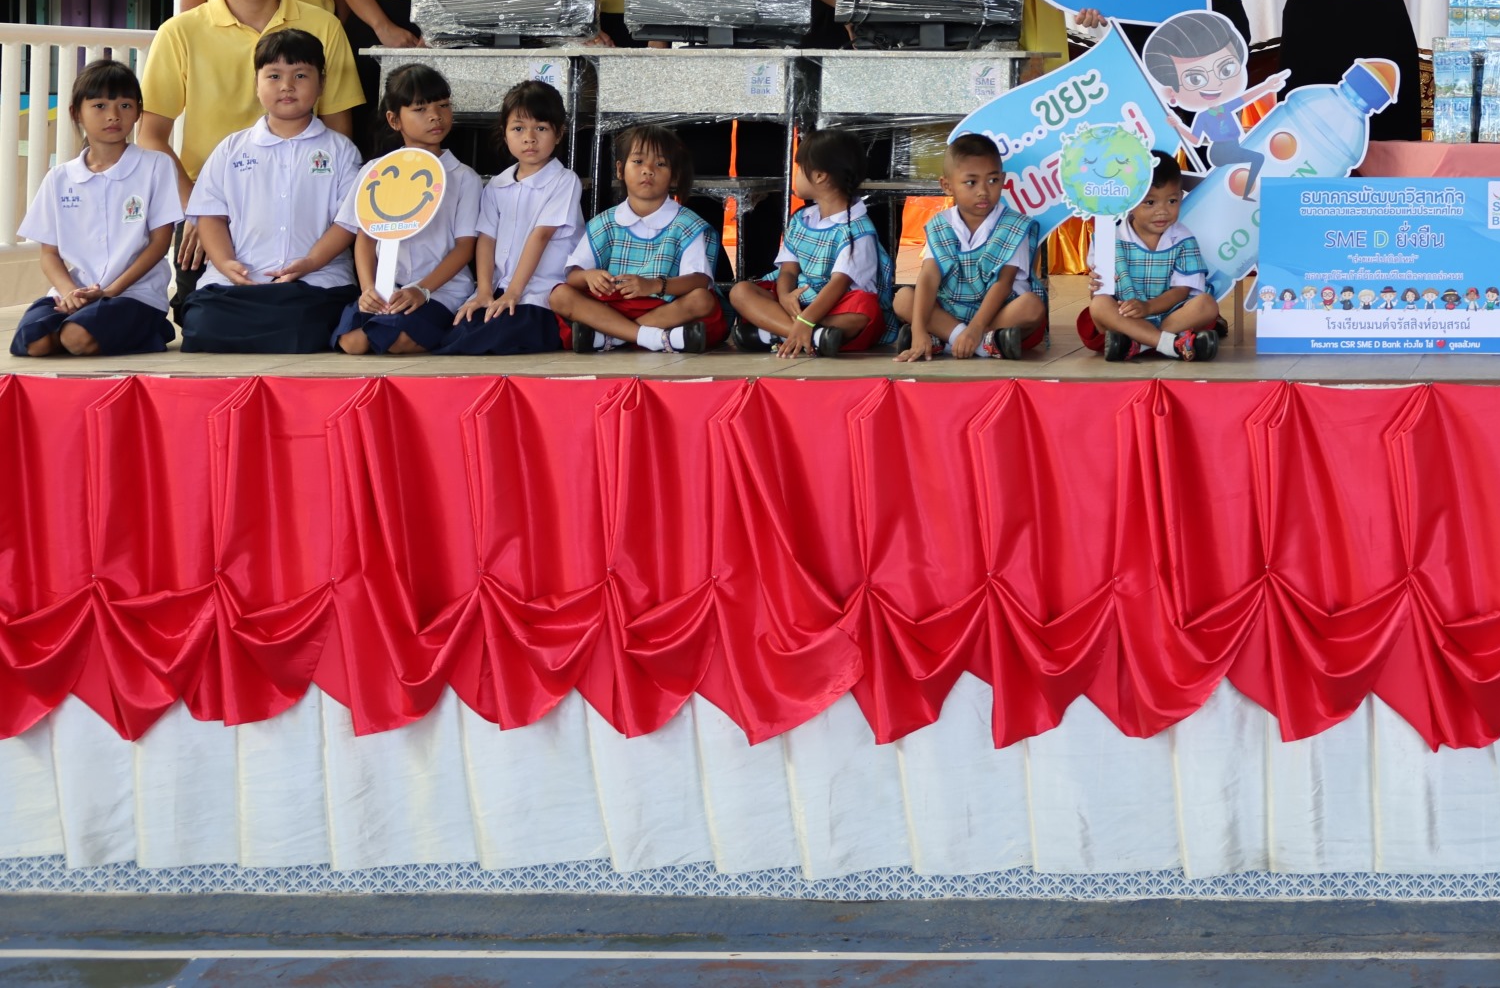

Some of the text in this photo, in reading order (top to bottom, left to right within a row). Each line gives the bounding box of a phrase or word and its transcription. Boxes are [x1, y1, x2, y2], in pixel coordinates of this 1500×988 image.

[534, 75, 555, 83] SME
[751, 76, 771, 85] SME
[975, 77, 996, 86] SME
[1084, 180, 1130, 197] รักษ์โลก
[1300, 186, 1466, 205] ธนาคารพัฒนาวิสาหกิจ
[370, 223, 390, 233] SME
[397, 221, 419, 230] Bank
[1323, 221, 1446, 249] SME D ยั่งยืน
[1217, 228, 1250, 262] GO
[1326, 316, 1472, 333] โรงเรียนมนต์จรัสสิงห์อนุสรณ์
[1310, 339, 1339, 349] โครงการ
[1340, 339, 1356, 349] CSR
[1357, 339, 1373, 349] SME
[1374, 339, 1381, 349] D
[1382, 339, 1401, 349] Bank
